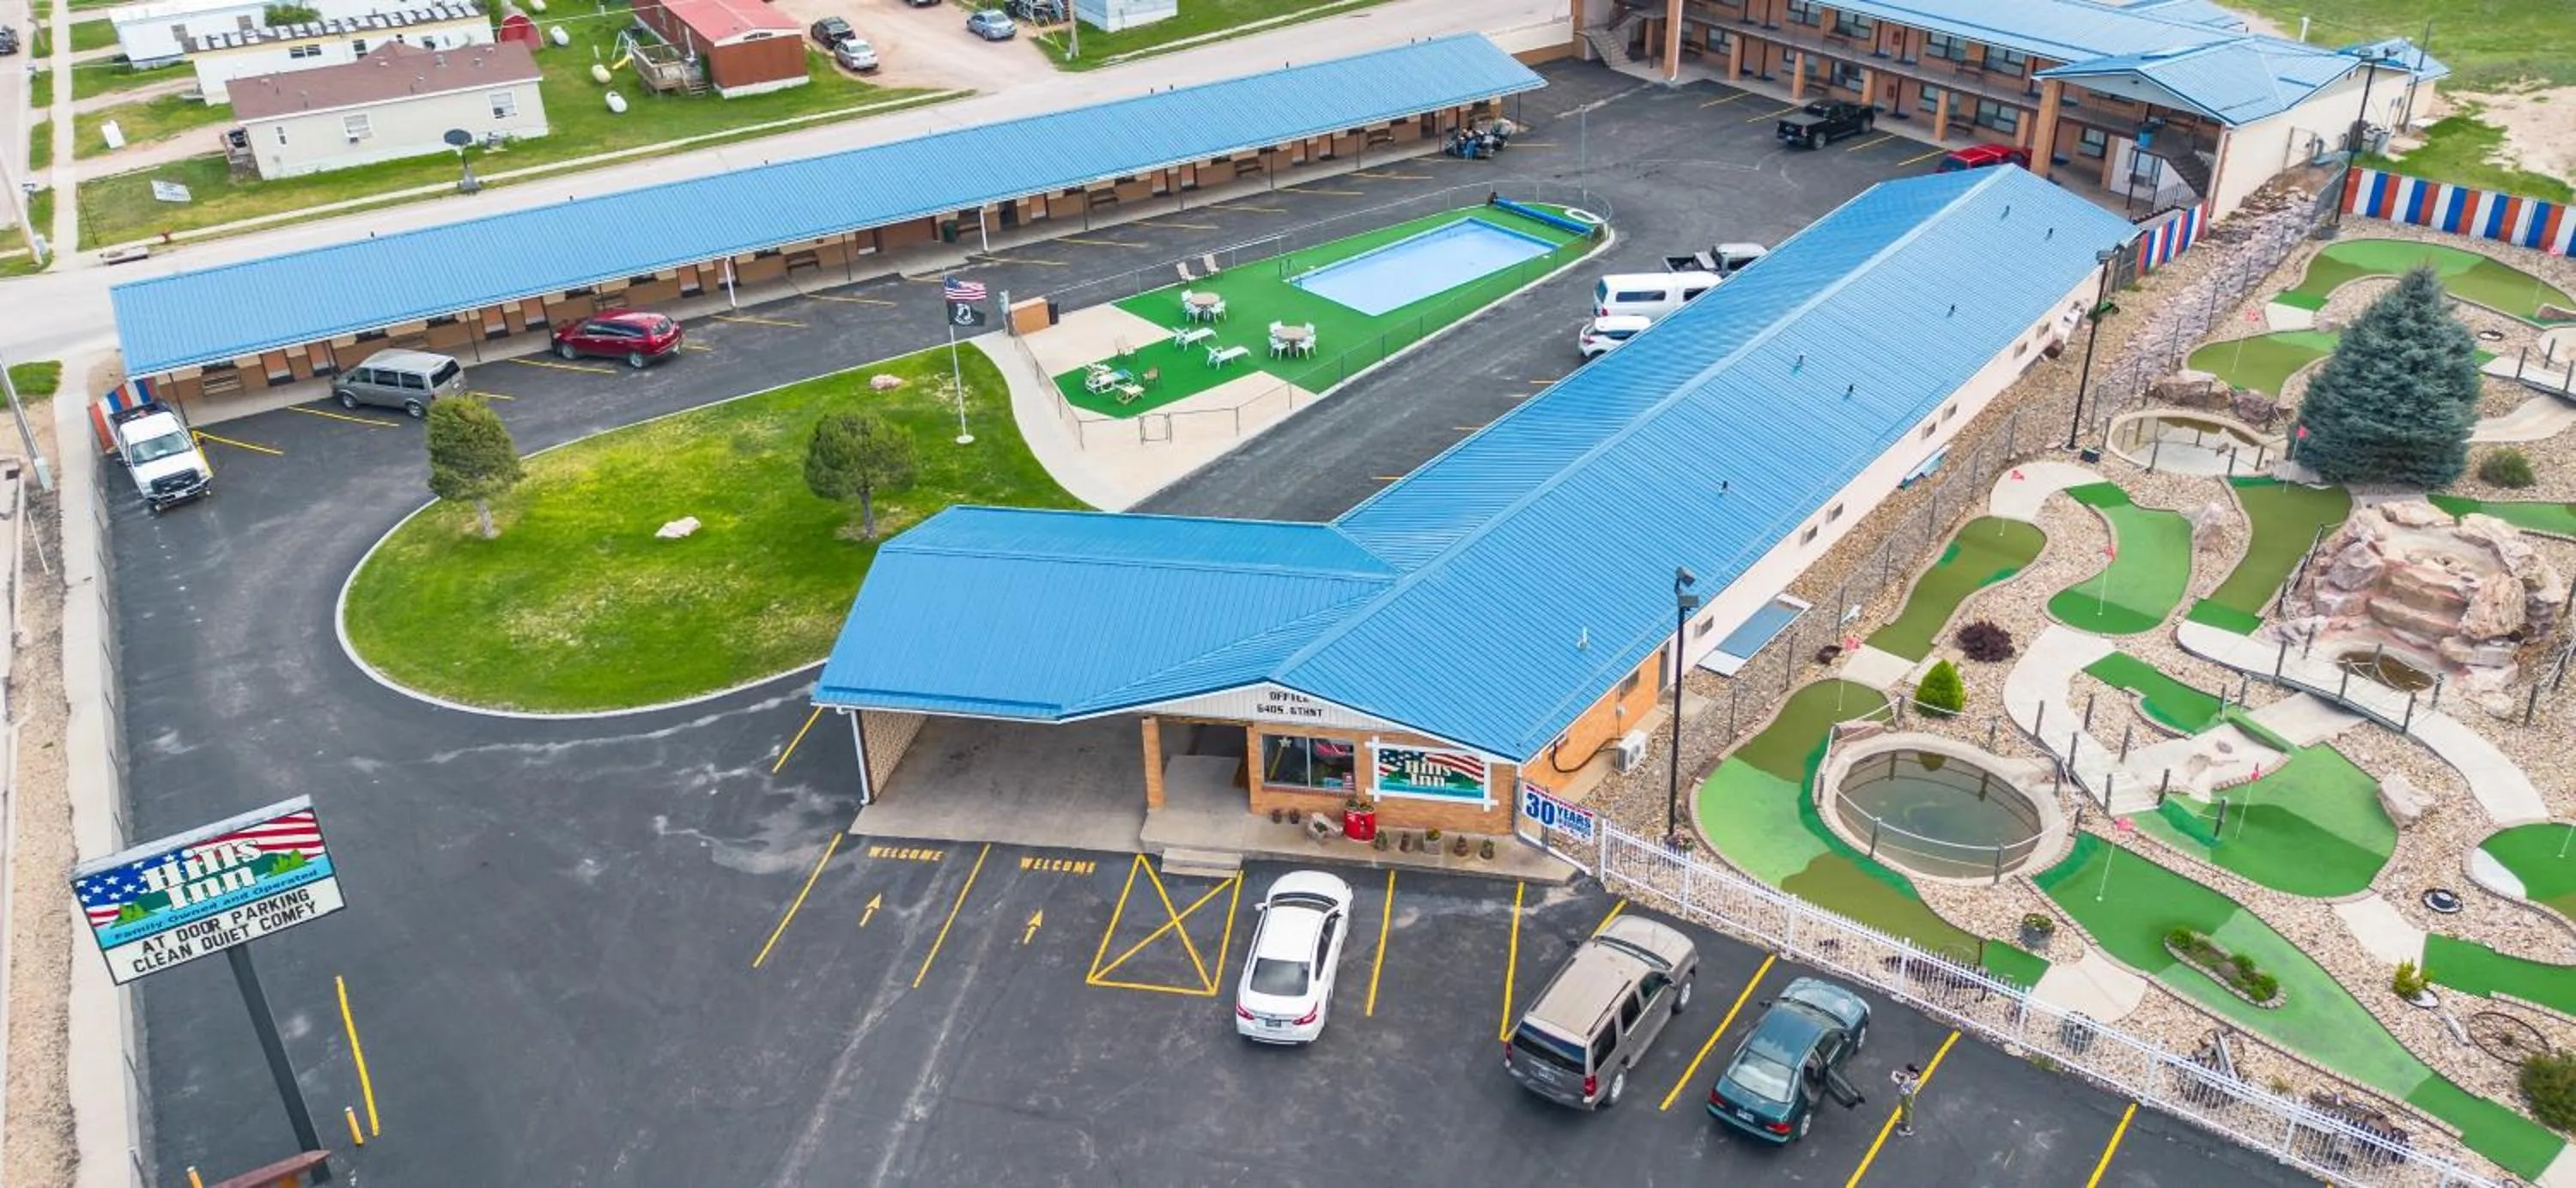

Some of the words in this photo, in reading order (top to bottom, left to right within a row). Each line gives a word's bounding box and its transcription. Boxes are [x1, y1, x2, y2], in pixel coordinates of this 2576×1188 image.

[1405, 755, 1451, 777] Hills
[1410, 773, 1446, 787] Inn
[1526, 792, 1555, 825] 30
[1557, 805, 1591, 828] YEARS
[143, 839, 262, 893] Hills
[868, 846, 944, 861] WELCOME
[1019, 857, 1097, 874] WELCOME
[114, 920, 163, 940] Family
[167, 902, 217, 924] Owned
[223, 892, 249, 906] and
[253, 869, 318, 895] Operated
[165, 866, 257, 910] Inn
[132, 943, 193, 973] CLEAN
[200, 923, 250, 951] QUIET
[259, 900, 317, 930] COMFY
[143, 935, 165, 954] AT
[176, 918, 222, 943] DOOR
[231, 888, 310, 924] PARKING
